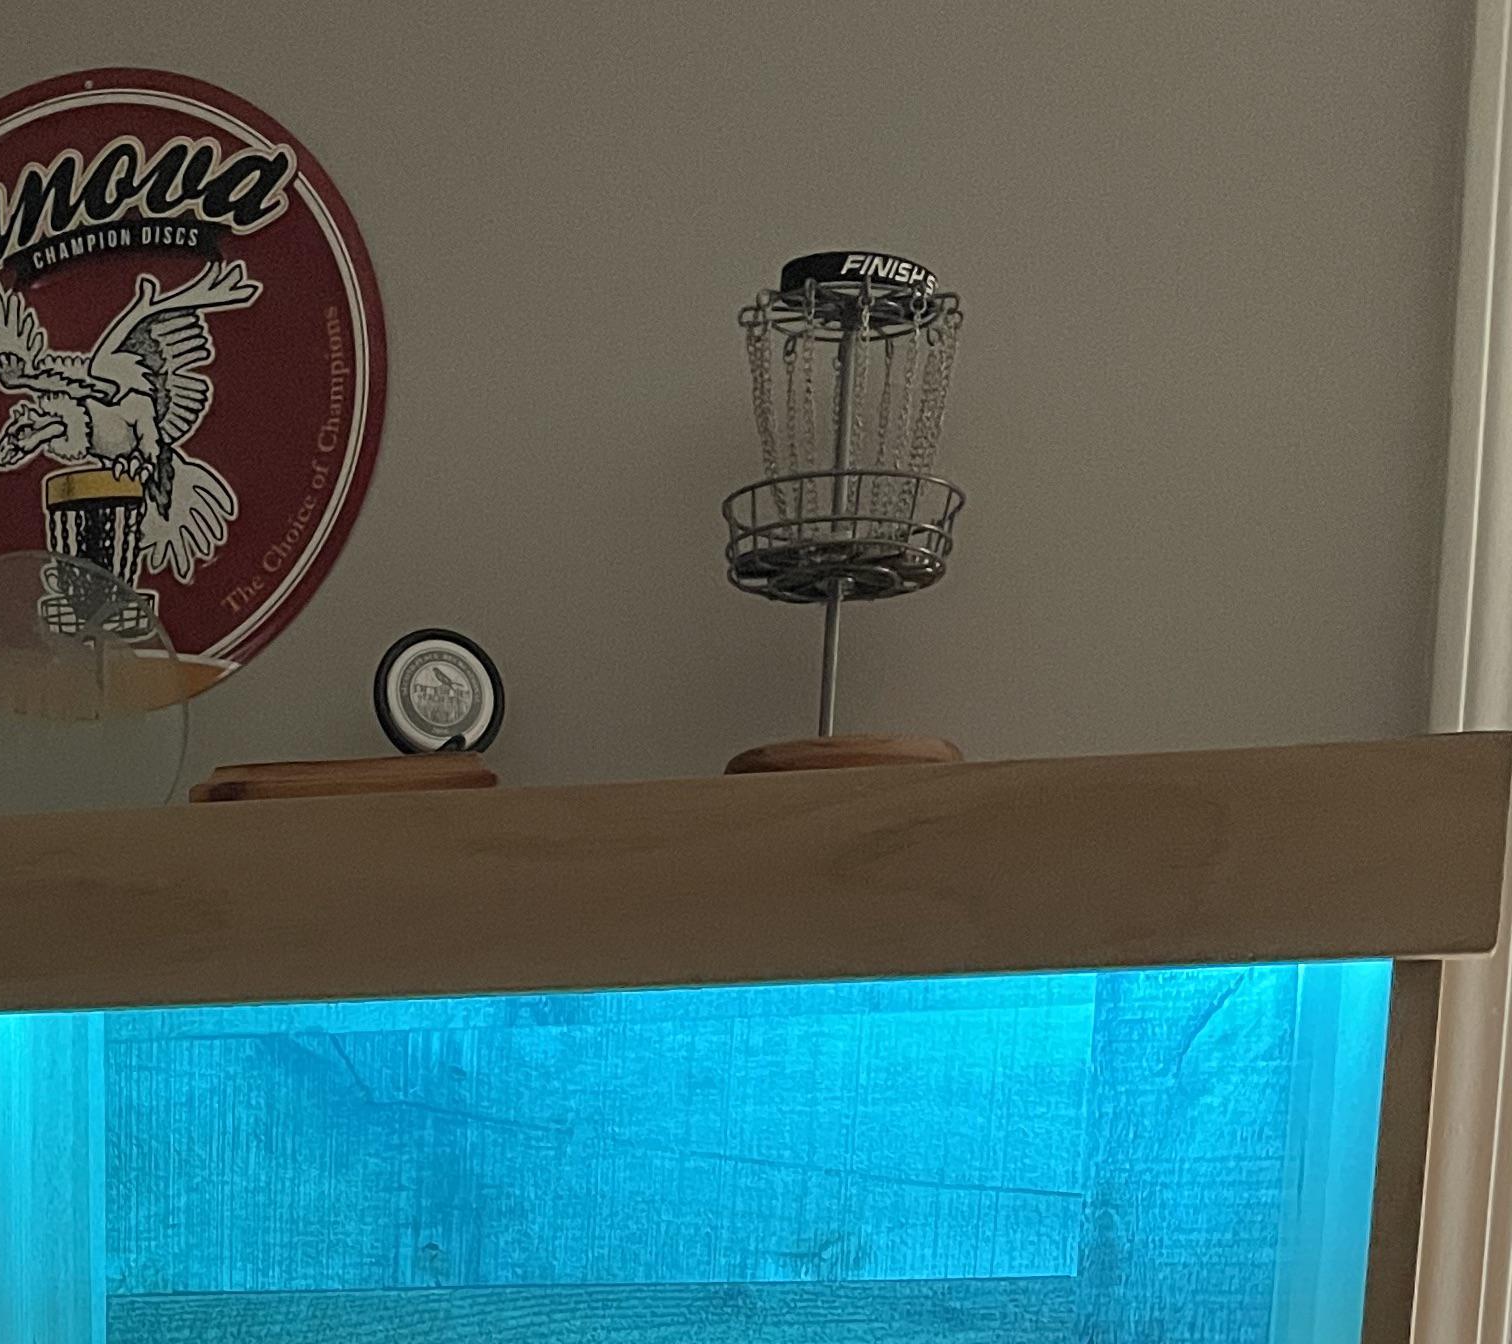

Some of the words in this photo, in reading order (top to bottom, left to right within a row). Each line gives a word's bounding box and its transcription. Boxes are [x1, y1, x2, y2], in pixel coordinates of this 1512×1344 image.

[32, 228, 131, 269] CHAMPION
[141, 226, 199, 247] DISCS
[317, 306, 350, 453] Champions
[311, 459, 330, 490] of
[262, 496, 317, 573] Choice
[221, 575, 265, 614] The
